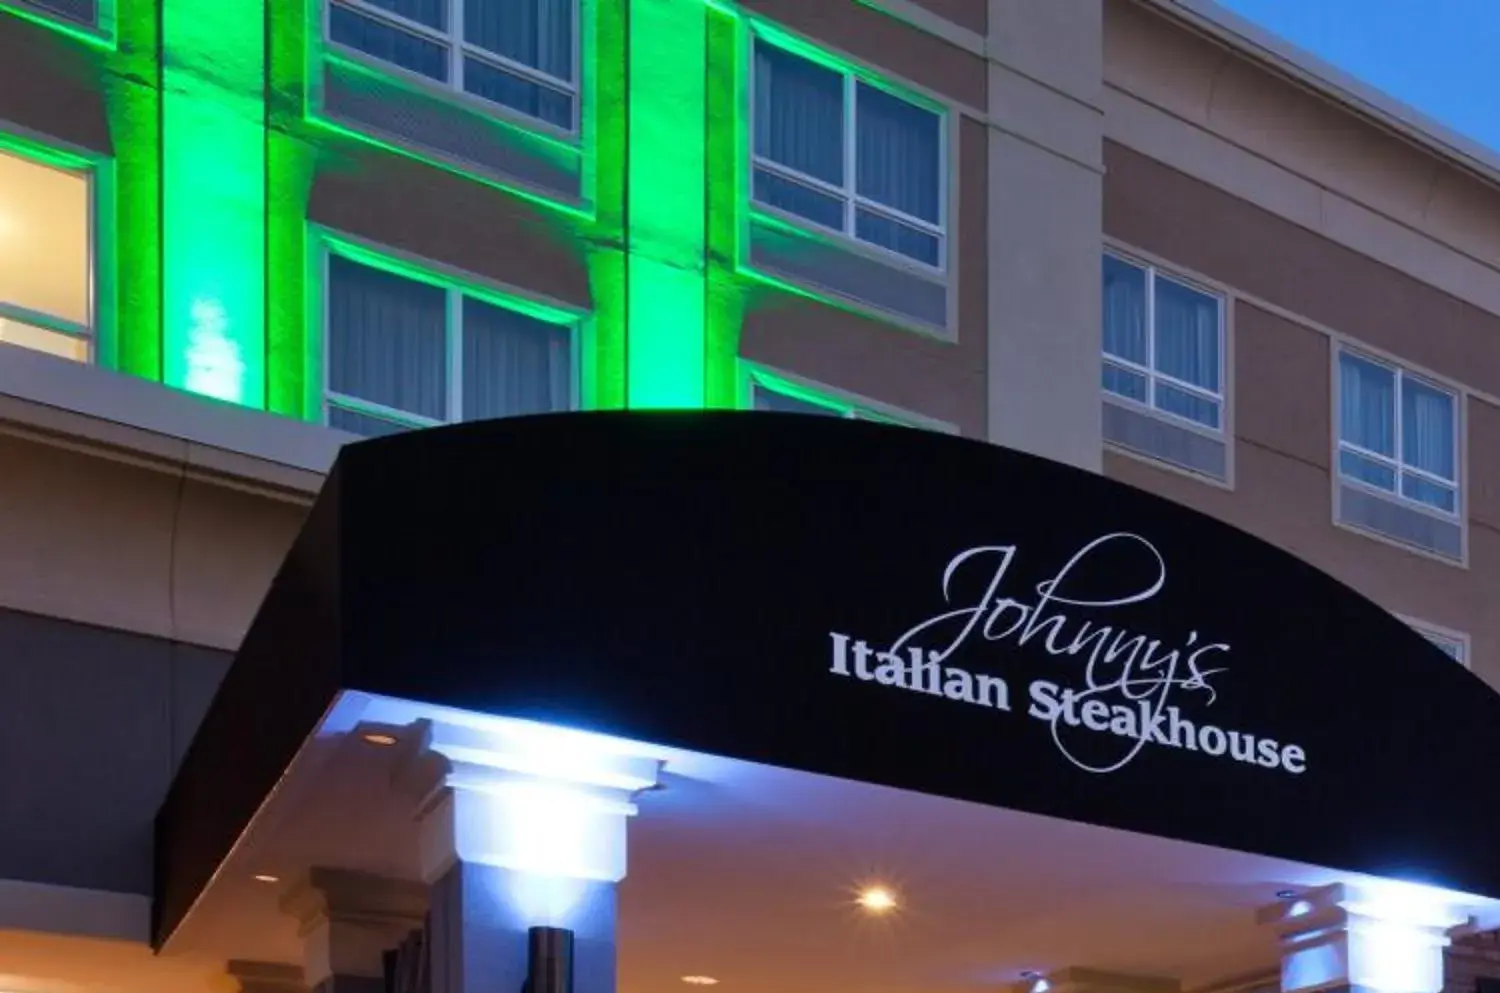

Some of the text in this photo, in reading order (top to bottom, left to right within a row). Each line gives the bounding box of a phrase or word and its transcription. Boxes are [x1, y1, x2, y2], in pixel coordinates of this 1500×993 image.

[829, 631, 1308, 774] Italian Steakhouse
[891, 532, 1230, 772] Johnny's
